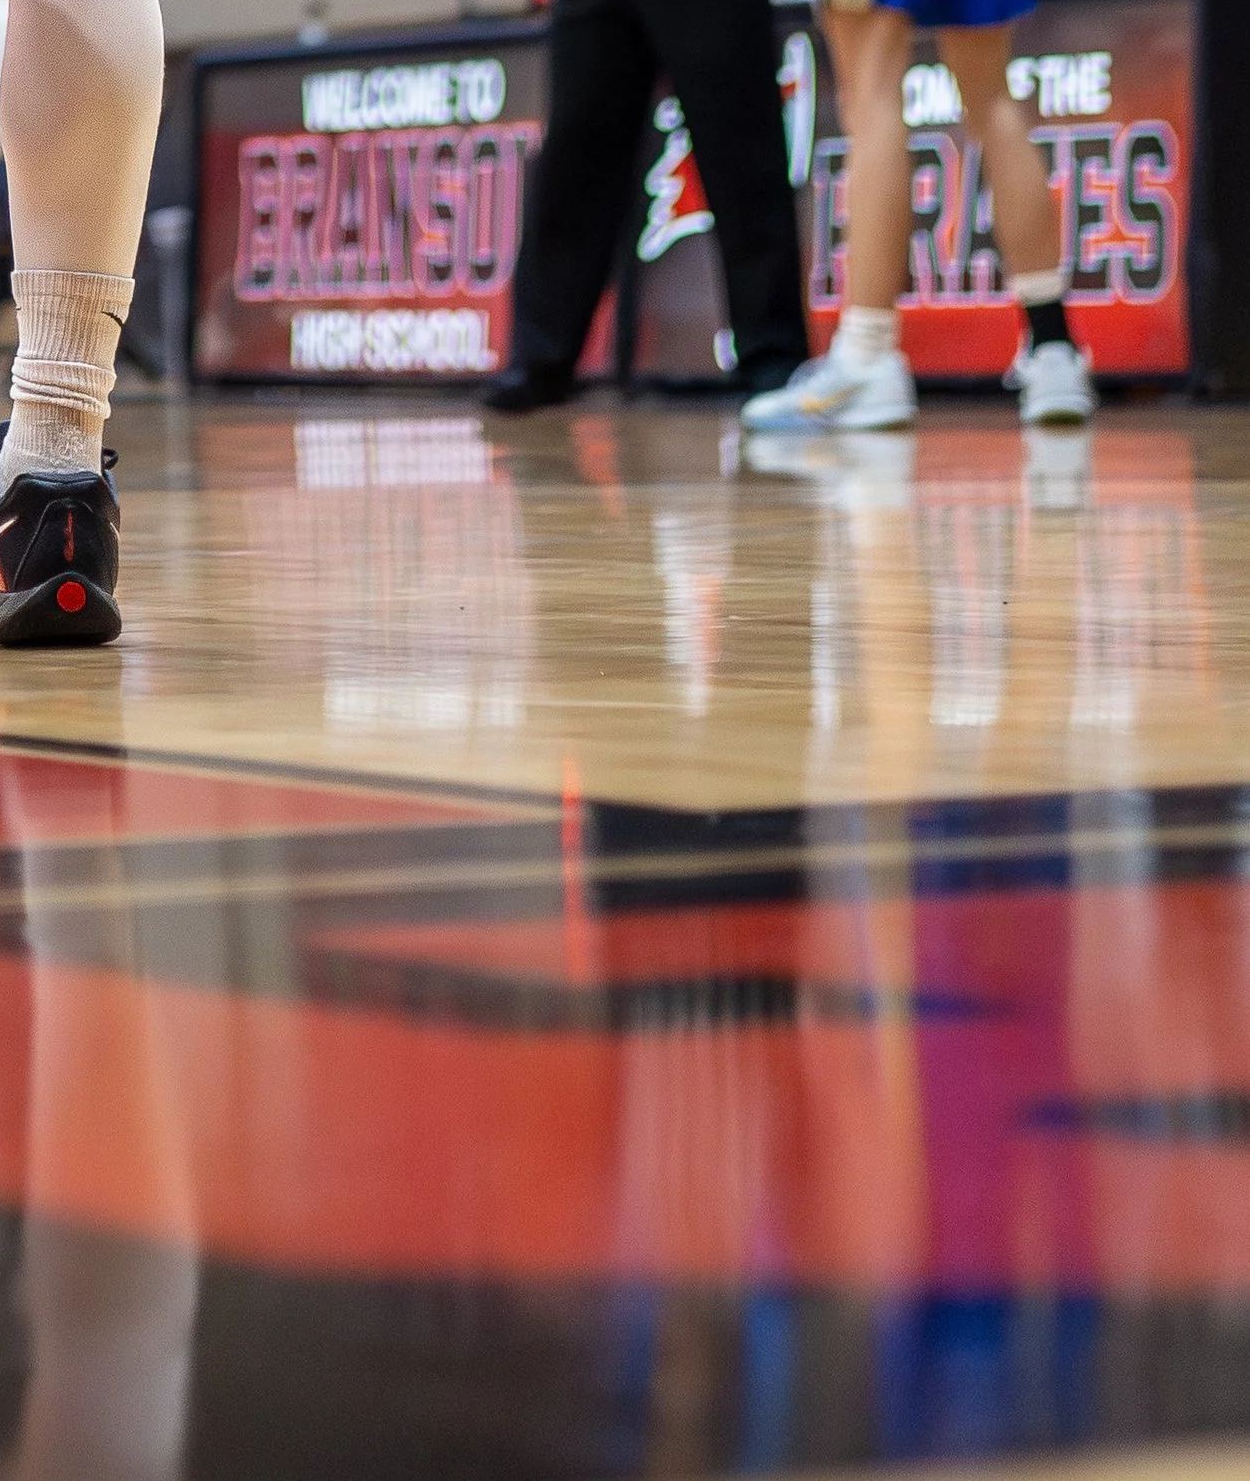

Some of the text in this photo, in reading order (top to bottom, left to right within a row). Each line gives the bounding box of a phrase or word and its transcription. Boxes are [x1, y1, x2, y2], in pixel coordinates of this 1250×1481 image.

[301, 57, 507, 134] WELCOME TO
[1035, 50, 1113, 118] THE
[234, 120, 544, 302] BRANSO
[289, 306, 499, 373] HIGH SCHOOL
